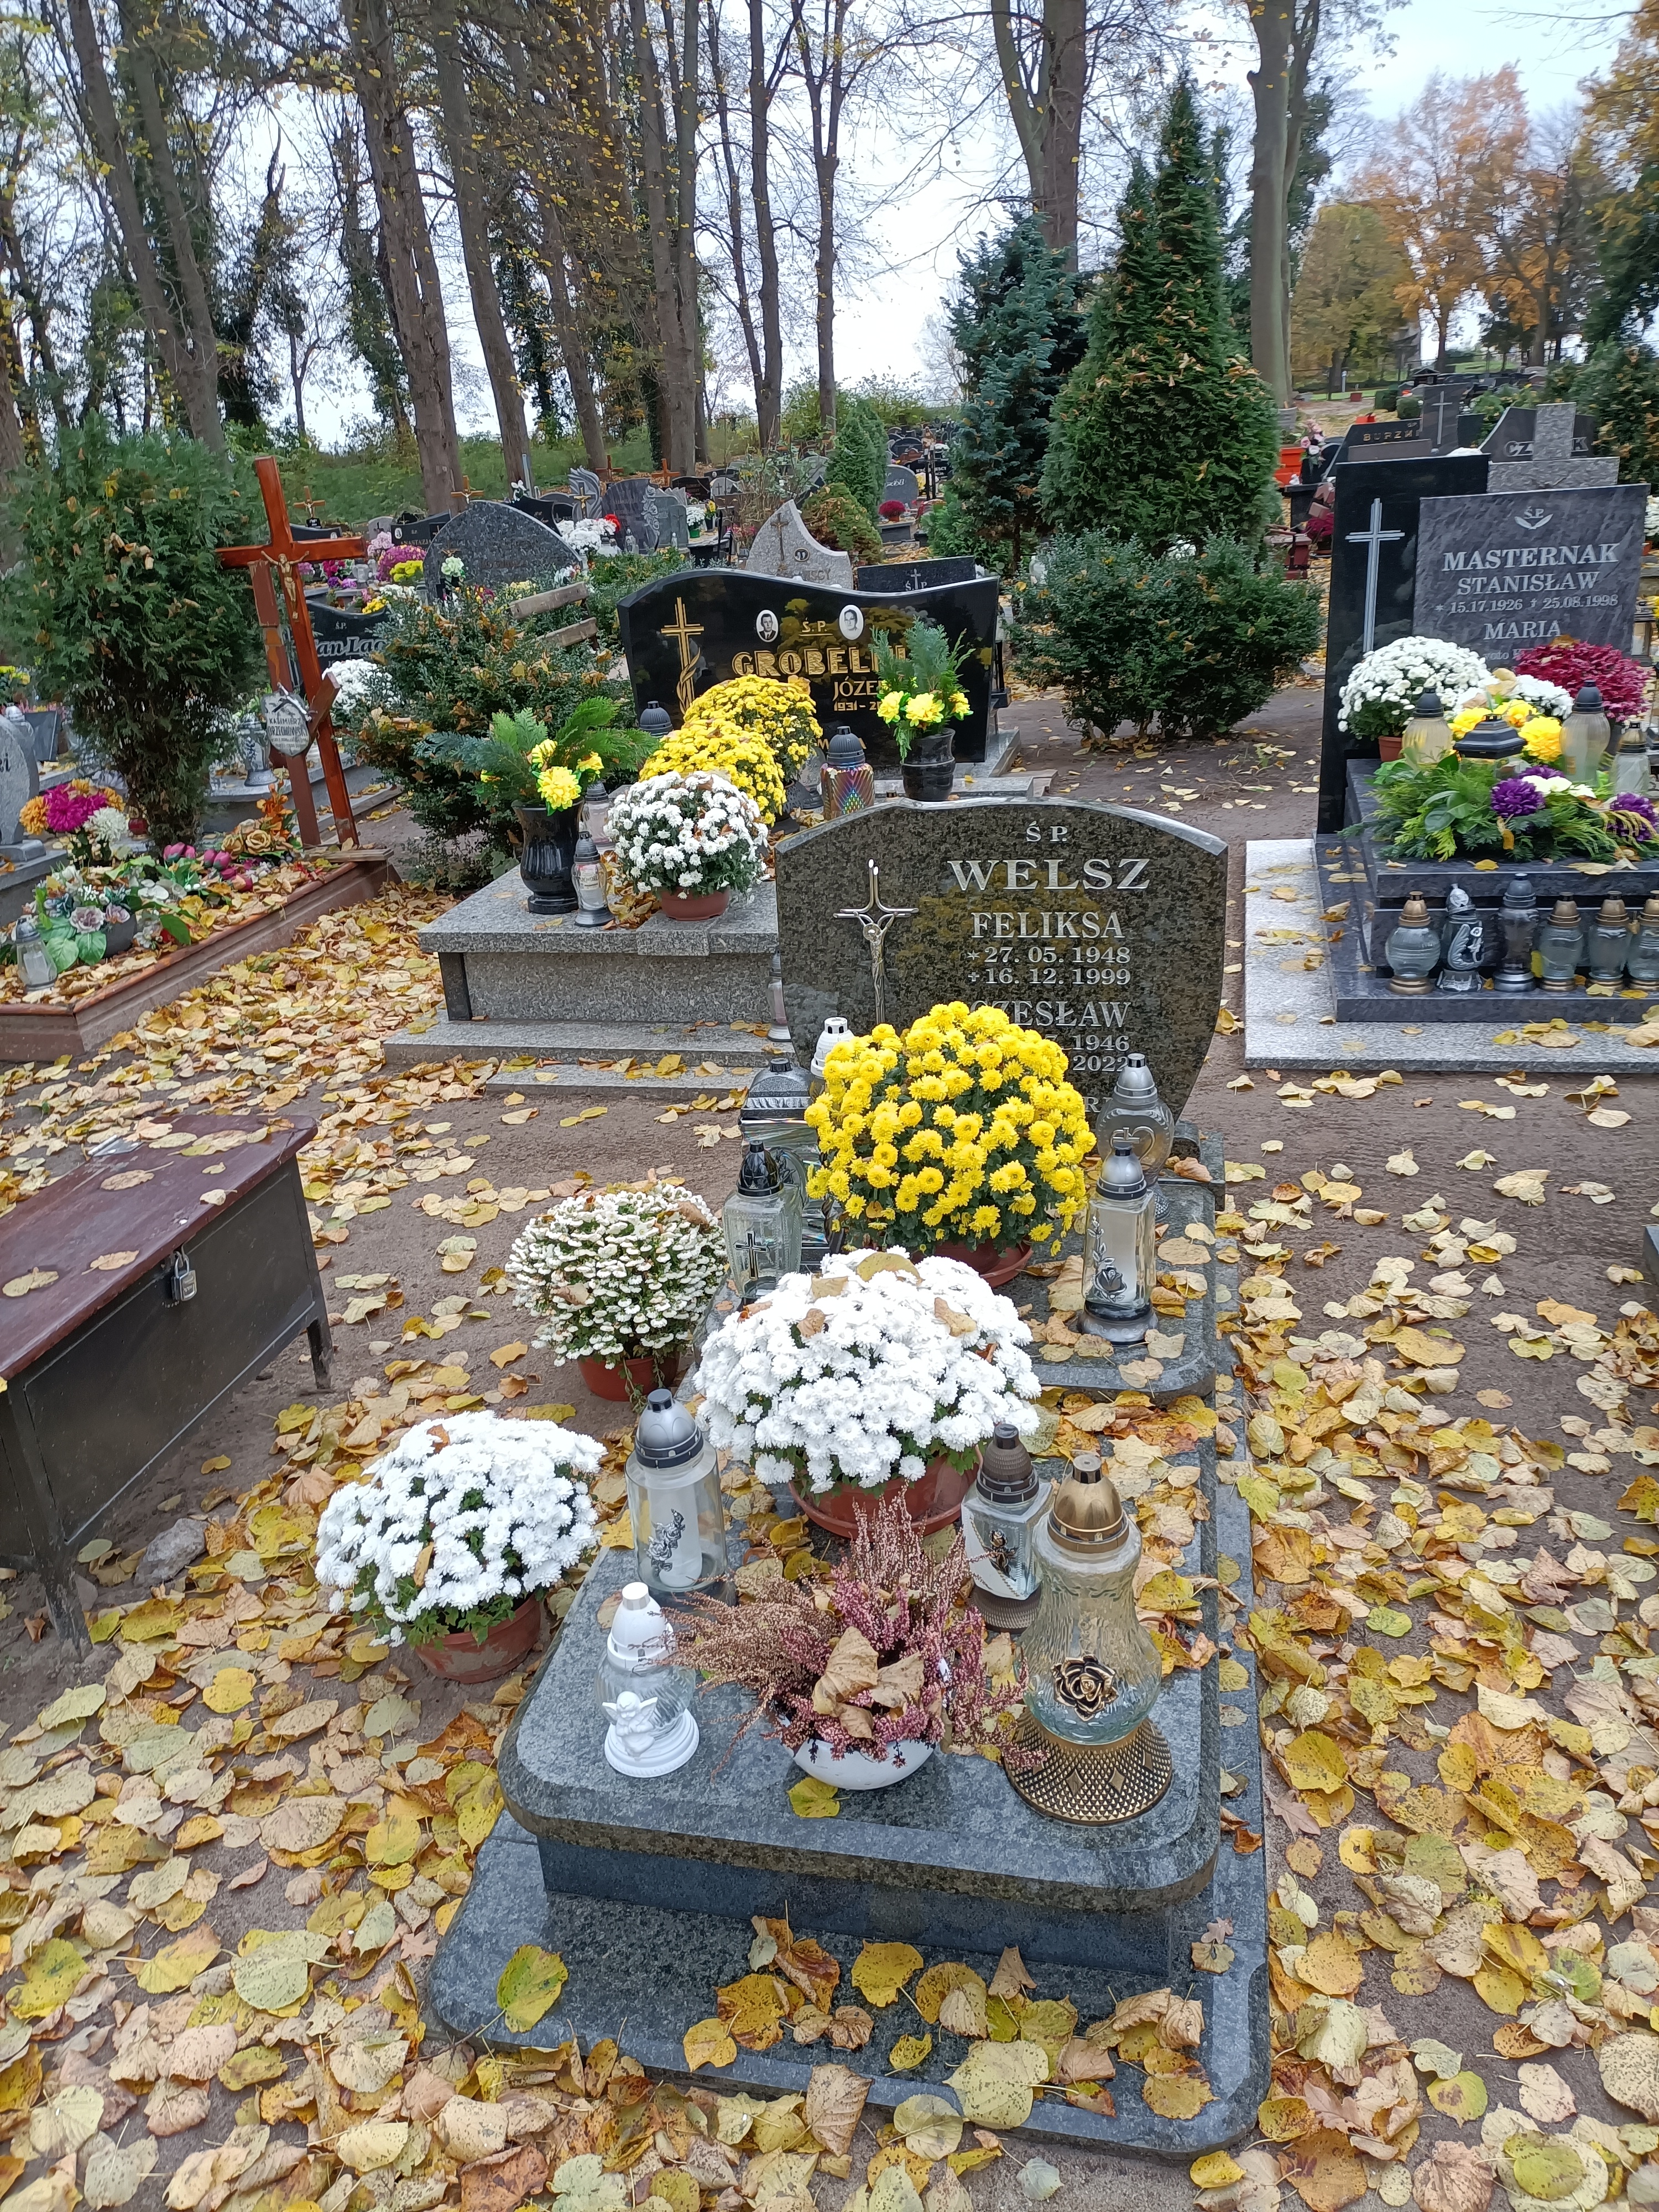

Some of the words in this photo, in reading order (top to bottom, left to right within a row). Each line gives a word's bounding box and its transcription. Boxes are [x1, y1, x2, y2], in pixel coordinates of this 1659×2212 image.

[1441, 542, 1620, 572] MASTERNAK
[1457, 571, 1600, 596] STANISŁAW
[1542, 594, 1618, 609] 25.08.1998
[1483, 619, 1563, 640] MARIA
[832, 676, 884, 701] JÓZE
[834, 700, 858, 711] 1931
[947, 858, 1151, 891] WELSZ
[971, 911, 1126, 938] FELIKSA
[1027, 946, 1065, 963] 05.
[1071, 946, 1131, 963] 1948
[1029, 968, 1065, 984] 12.
[1072, 968, 1131, 985] 1999
[1072, 1034, 1130, 1051] 1946
[1072, 1055, 1129, 1072] 2022
